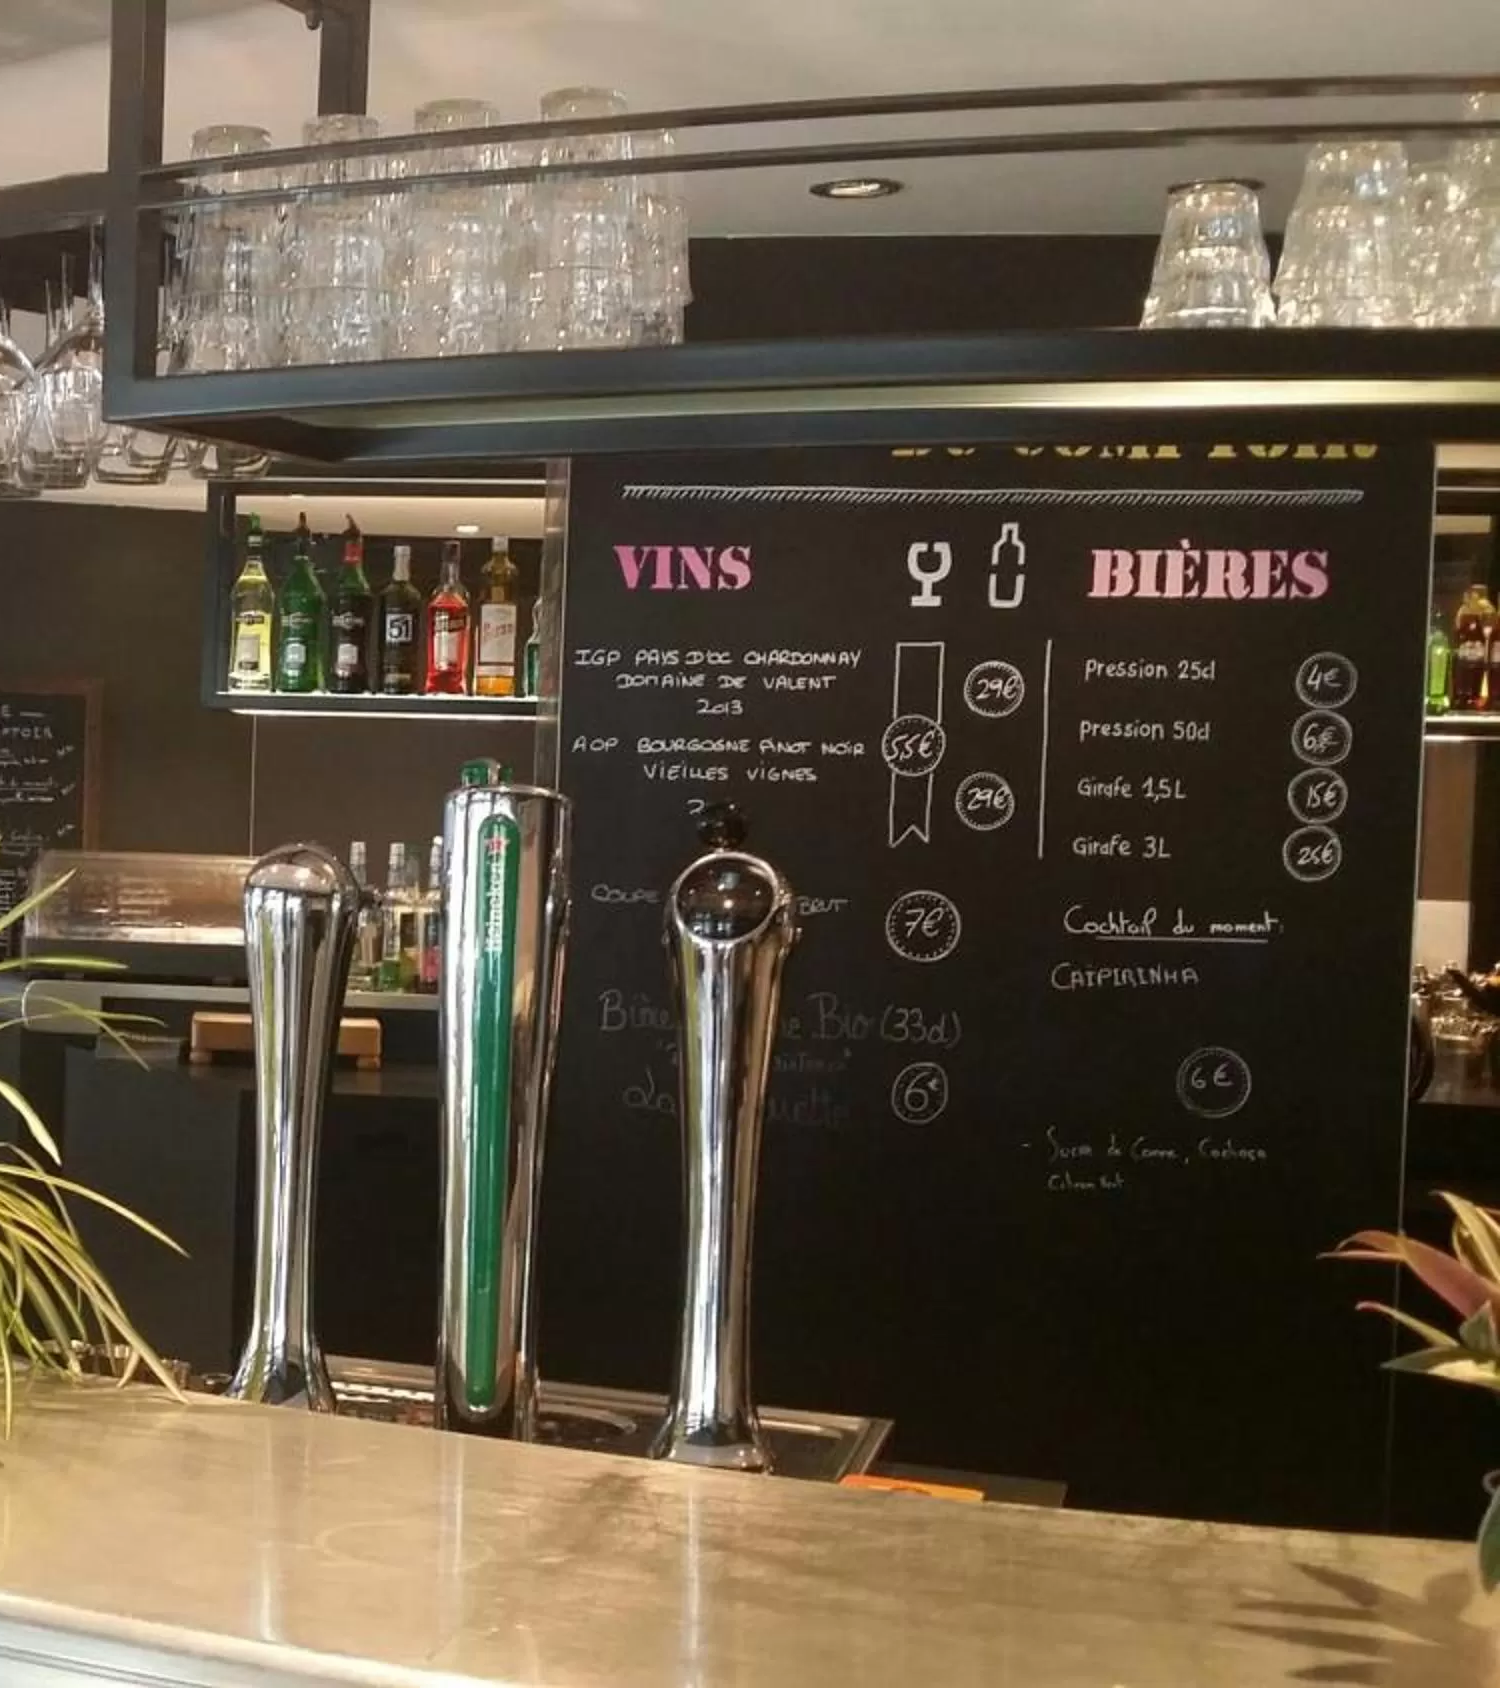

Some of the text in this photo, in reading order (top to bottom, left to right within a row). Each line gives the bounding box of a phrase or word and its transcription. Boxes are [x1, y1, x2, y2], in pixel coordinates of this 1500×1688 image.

[612, 545, 752, 591] VINS
[1087, 538, 1329, 600] BIÈRES
[573, 649, 621, 666] IGP
[635, 649, 680, 666] PAYS
[743, 649, 863, 669] CHARDONNAY
[1084, 658, 1169, 682] Pression
[717, 675, 747, 689] DE
[762, 675, 837, 690] VALENT
[1306, 662, 1342, 691] 4€
[696, 699, 744, 716] 2013
[1079, 720, 1165, 743] Pression
[571, 735, 620, 752] AOP
[636, 736, 751, 753] BOURGOGNE
[1077, 776, 1133, 799] Girafe
[1072, 834, 1132, 857] Girafe
[903, 907, 945, 940] 7€
[1172, 907, 1195, 935] du
[1051, 962, 1200, 992] CAIPIRINHA
